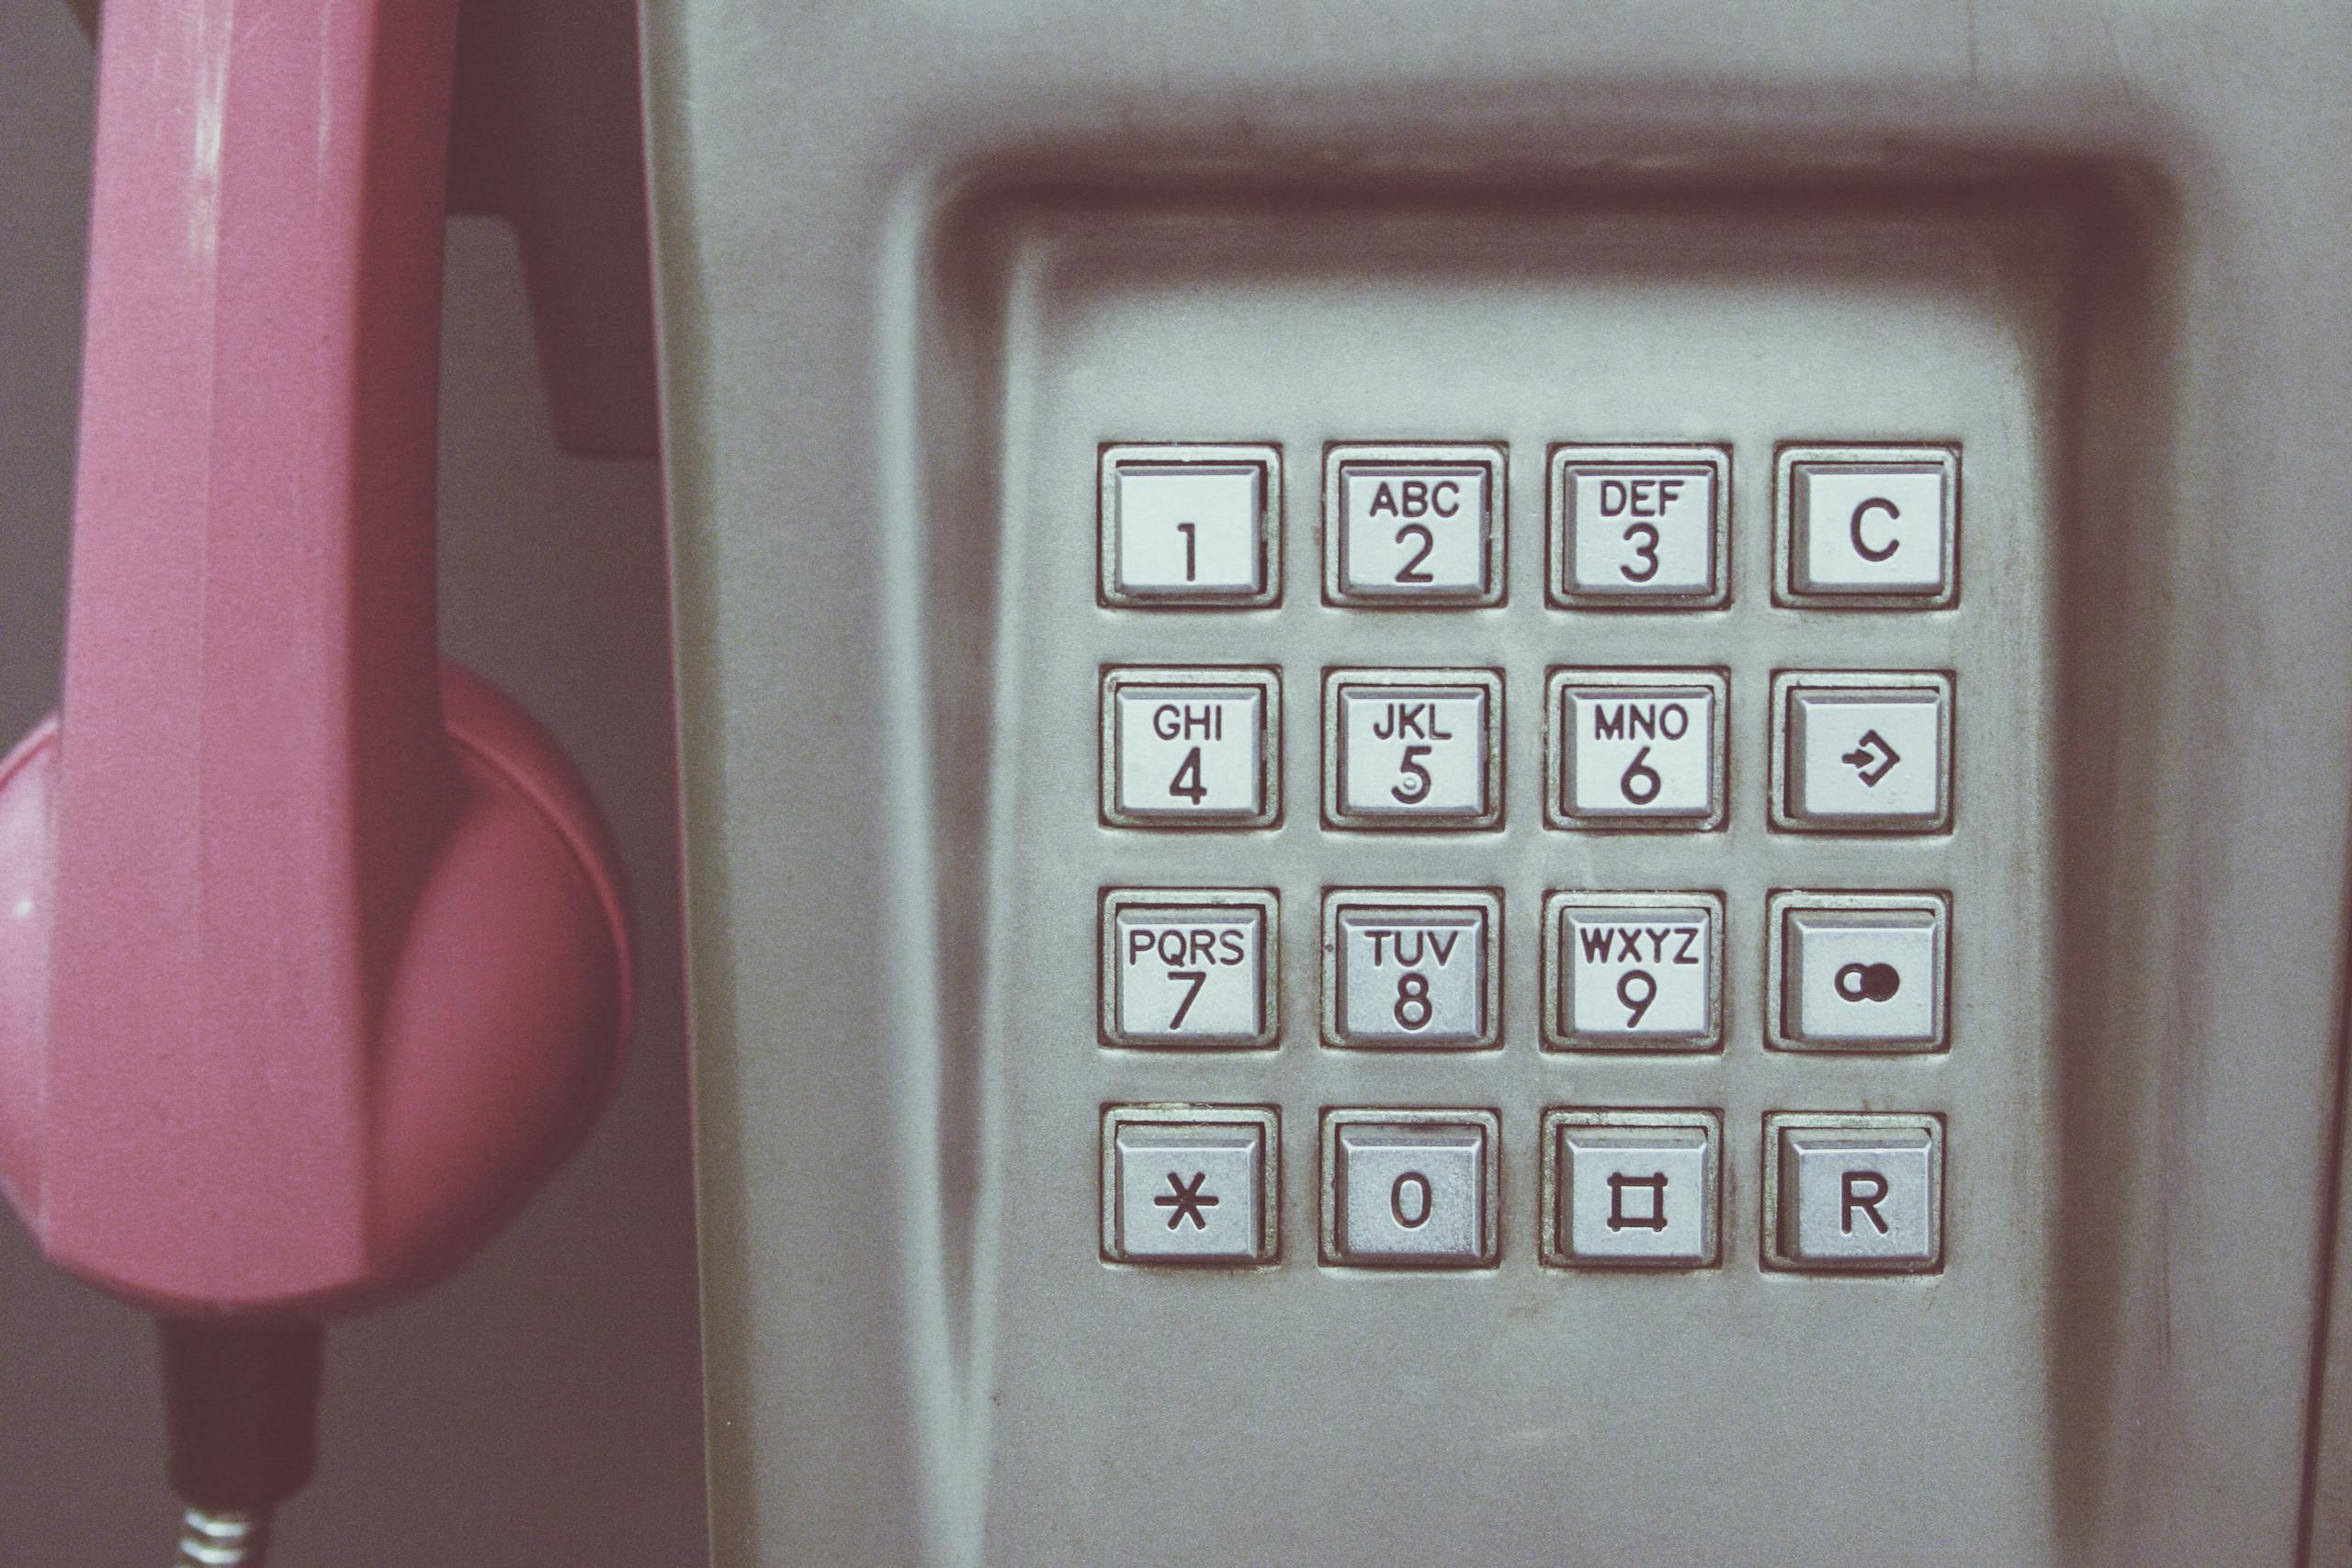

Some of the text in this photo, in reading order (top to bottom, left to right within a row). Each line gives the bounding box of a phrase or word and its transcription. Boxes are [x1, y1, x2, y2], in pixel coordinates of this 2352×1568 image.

[1369, 481, 1461, 517] ABC
[1600, 480, 1685, 516] DEF
[1176, 524, 1197, 582] 1
[1396, 522, 1434, 583] 2
[1621, 522, 1660, 583] 3
[1850, 497, 1901, 562] C
[1153, 705, 1223, 741] GHI
[1374, 704, 1453, 740] JKL
[1595, 704, 1690, 741] MNO
[1170, 747, 1208, 806] 4
[1391, 745, 1432, 806] 5
[1621, 746, 1662, 806] 6
[1129, 930, 1245, 968] PQRS
[1363, 930, 1458, 966] TUV
[1580, 927, 1701, 964] WXYZ
[1168, 970, 1207, 1031] 7
[1394, 970, 1433, 1031] 8
[1617, 970, 1657, 1030] 9
[1842, 1170, 1890, 1234] R
